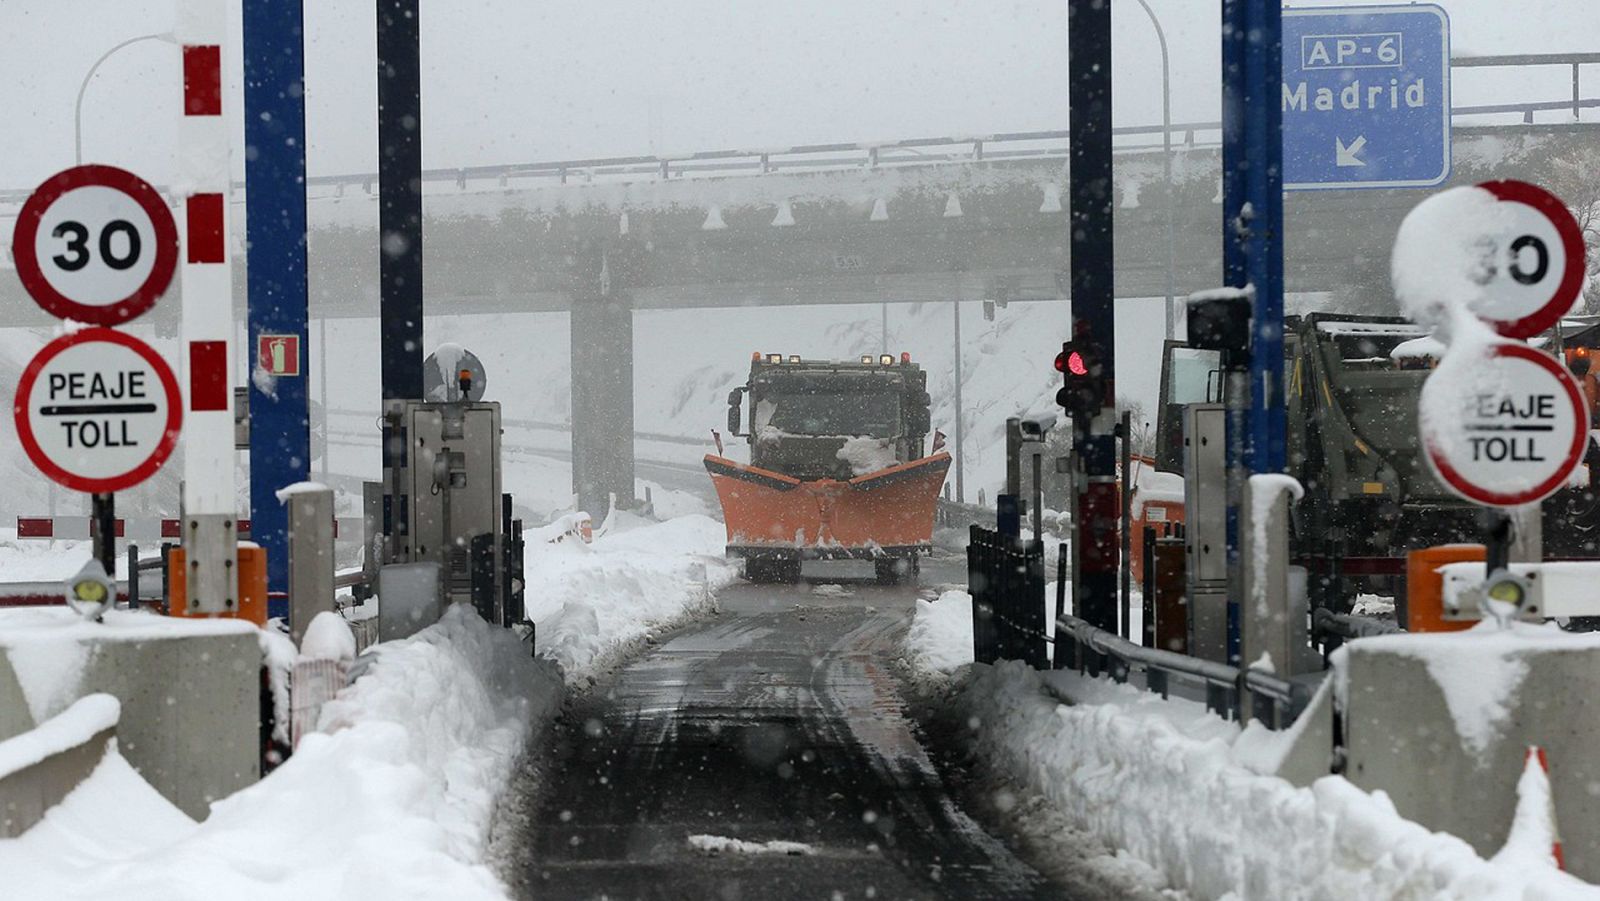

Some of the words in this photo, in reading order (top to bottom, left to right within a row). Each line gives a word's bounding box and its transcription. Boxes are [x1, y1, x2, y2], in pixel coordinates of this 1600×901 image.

[1307, 38, 1397, 65] AP-6
[1281, 78, 1425, 112] Madrid
[51, 219, 142, 271] 30
[49, 371, 146, 400] PEAJE
[60, 420, 138, 448] TOLL
[1467, 437, 1545, 462] TOLL
